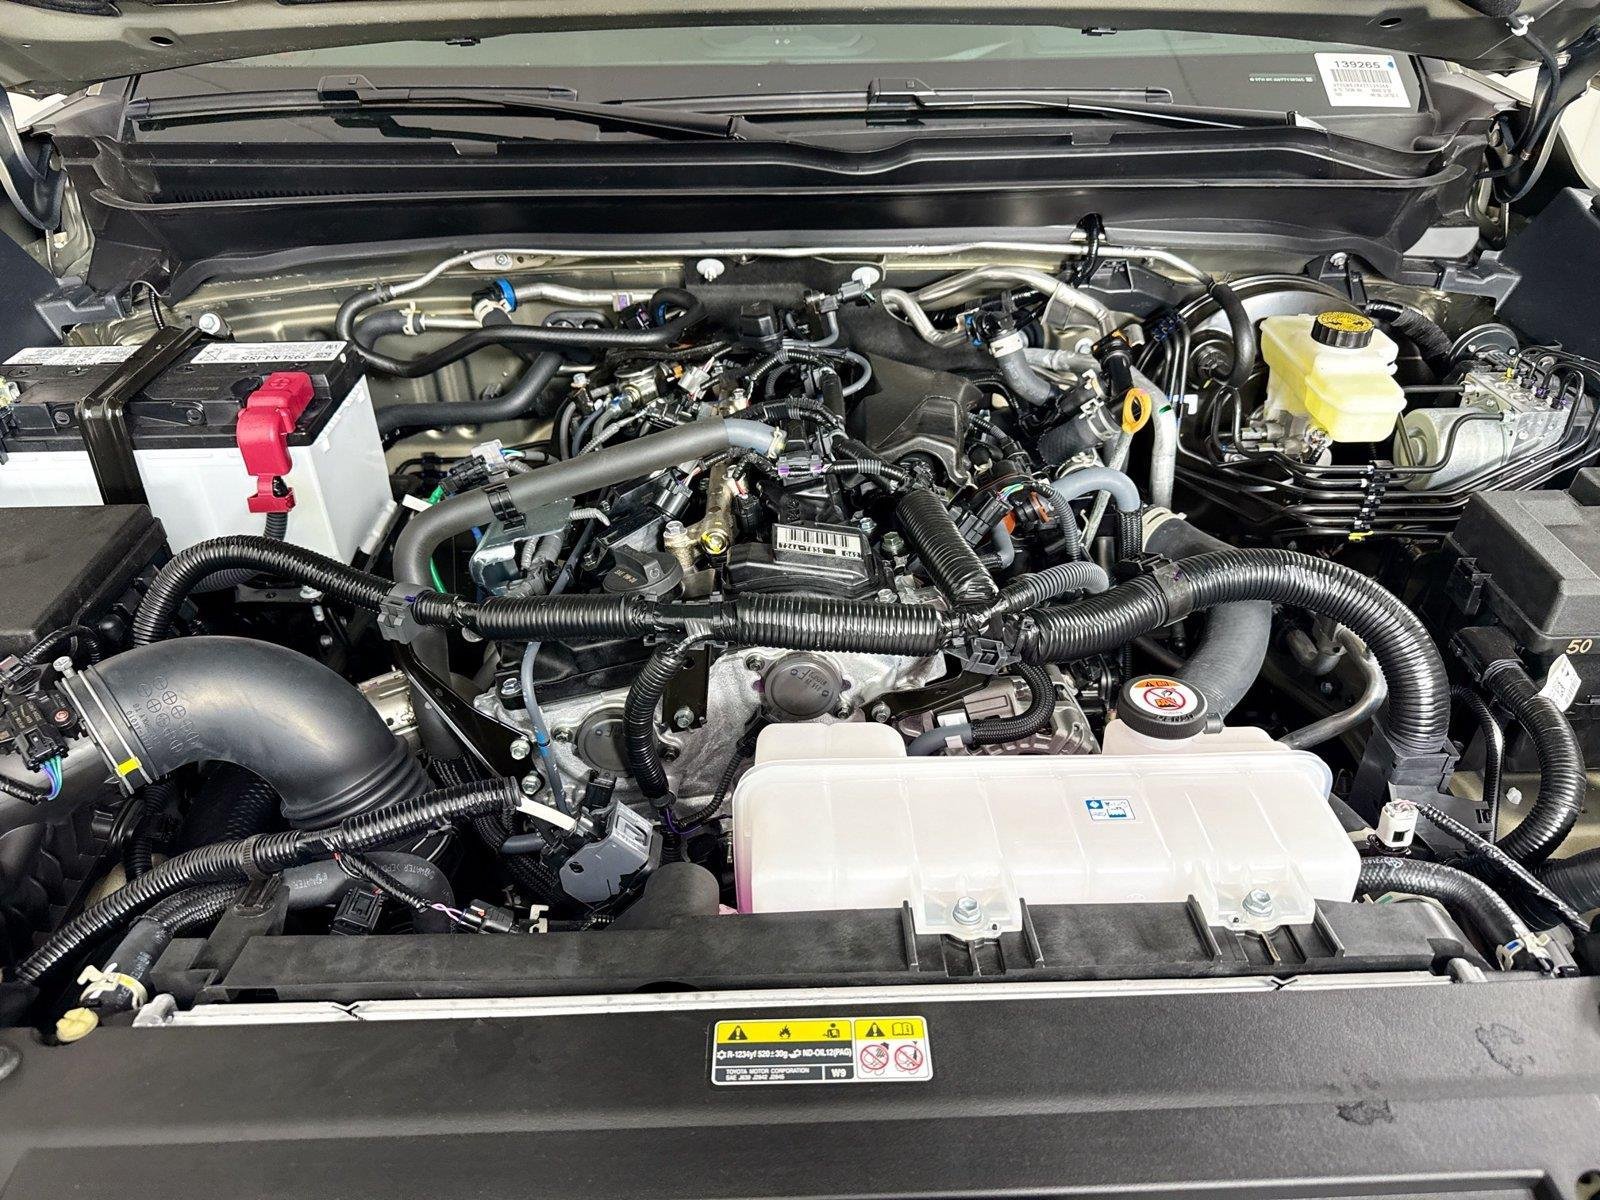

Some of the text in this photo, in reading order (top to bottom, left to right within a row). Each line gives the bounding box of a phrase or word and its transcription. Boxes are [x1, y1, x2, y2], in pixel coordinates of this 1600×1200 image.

[1334, 60, 1381, 69] 139265
[1565, 638, 1593, 655] 50
[727, 1050, 757, 1060] R-1234yf
[830, 1067, 847, 1078] W9
